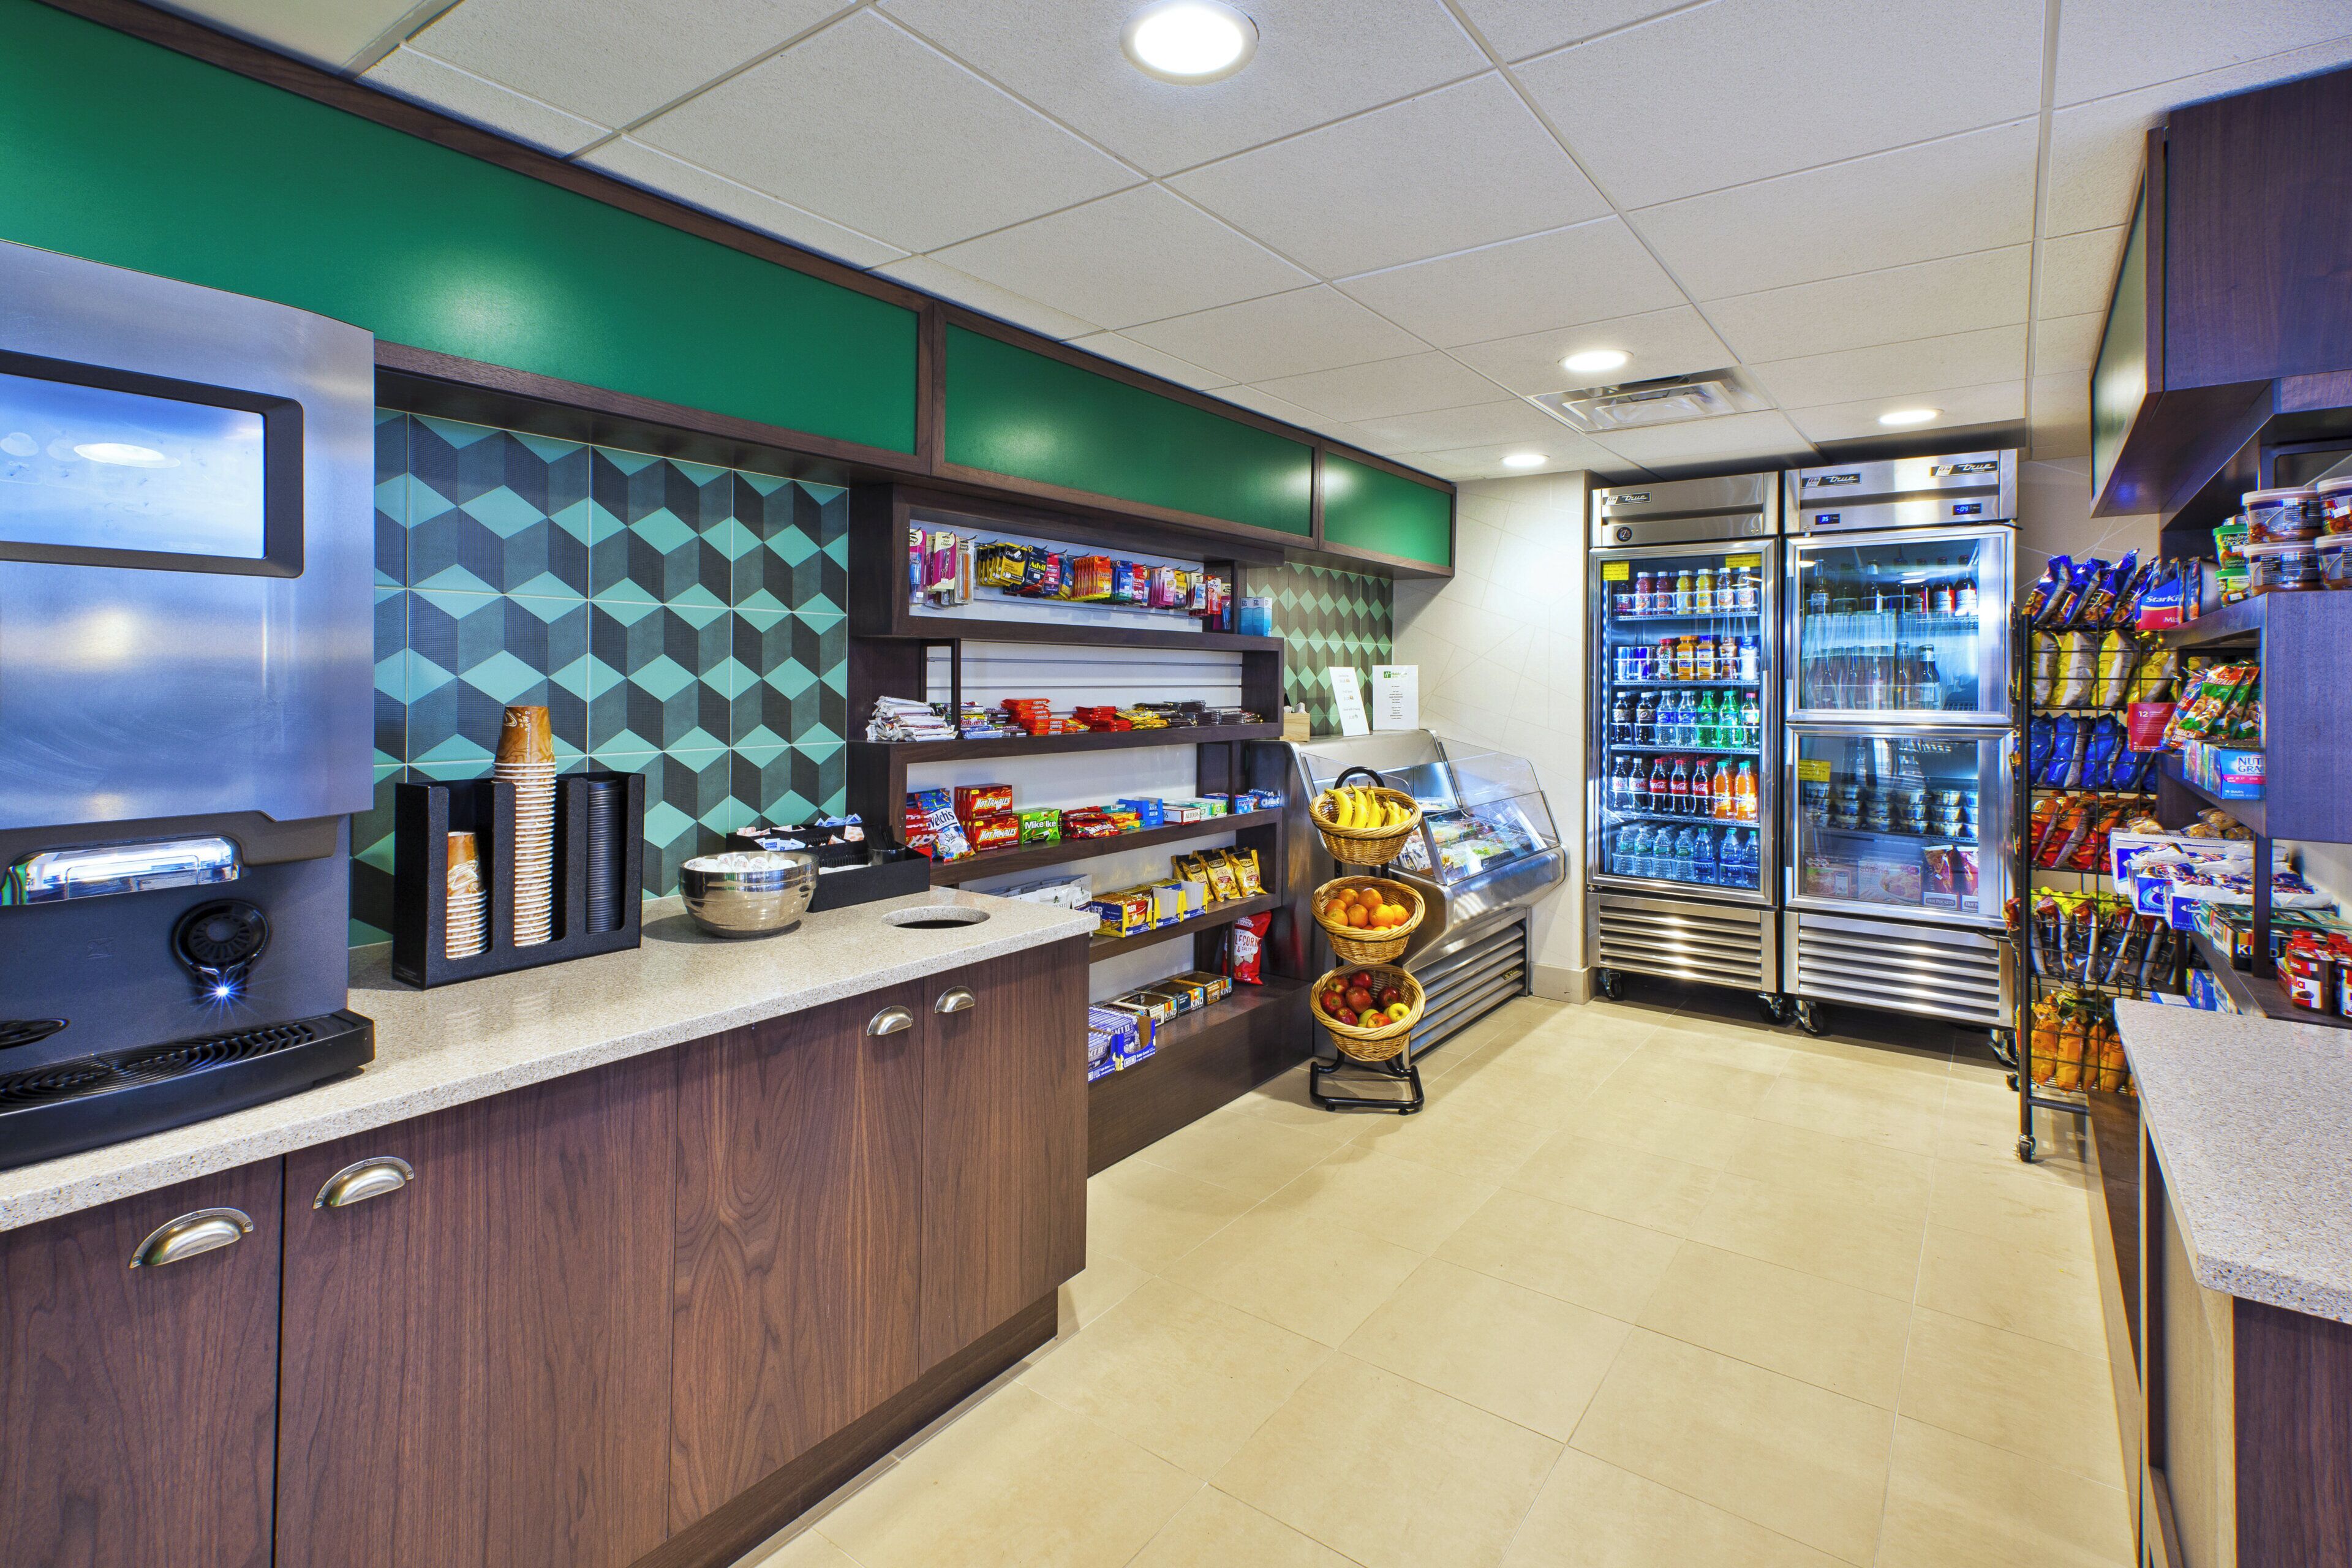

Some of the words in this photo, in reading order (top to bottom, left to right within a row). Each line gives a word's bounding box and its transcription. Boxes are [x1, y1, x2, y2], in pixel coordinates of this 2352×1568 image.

[1030, 561, 1046, 571] Advil
[2205, 677, 2236, 685] EMERALD
[975, 799, 987, 810] HOT
[1025, 821, 1043, 830] Mike
[979, 830, 993, 841] HOT
[1221, 986, 1232, 996] KIND
[1191, 998, 1204, 1008] KIND
[1165, 1009, 1177, 1019] KIND
